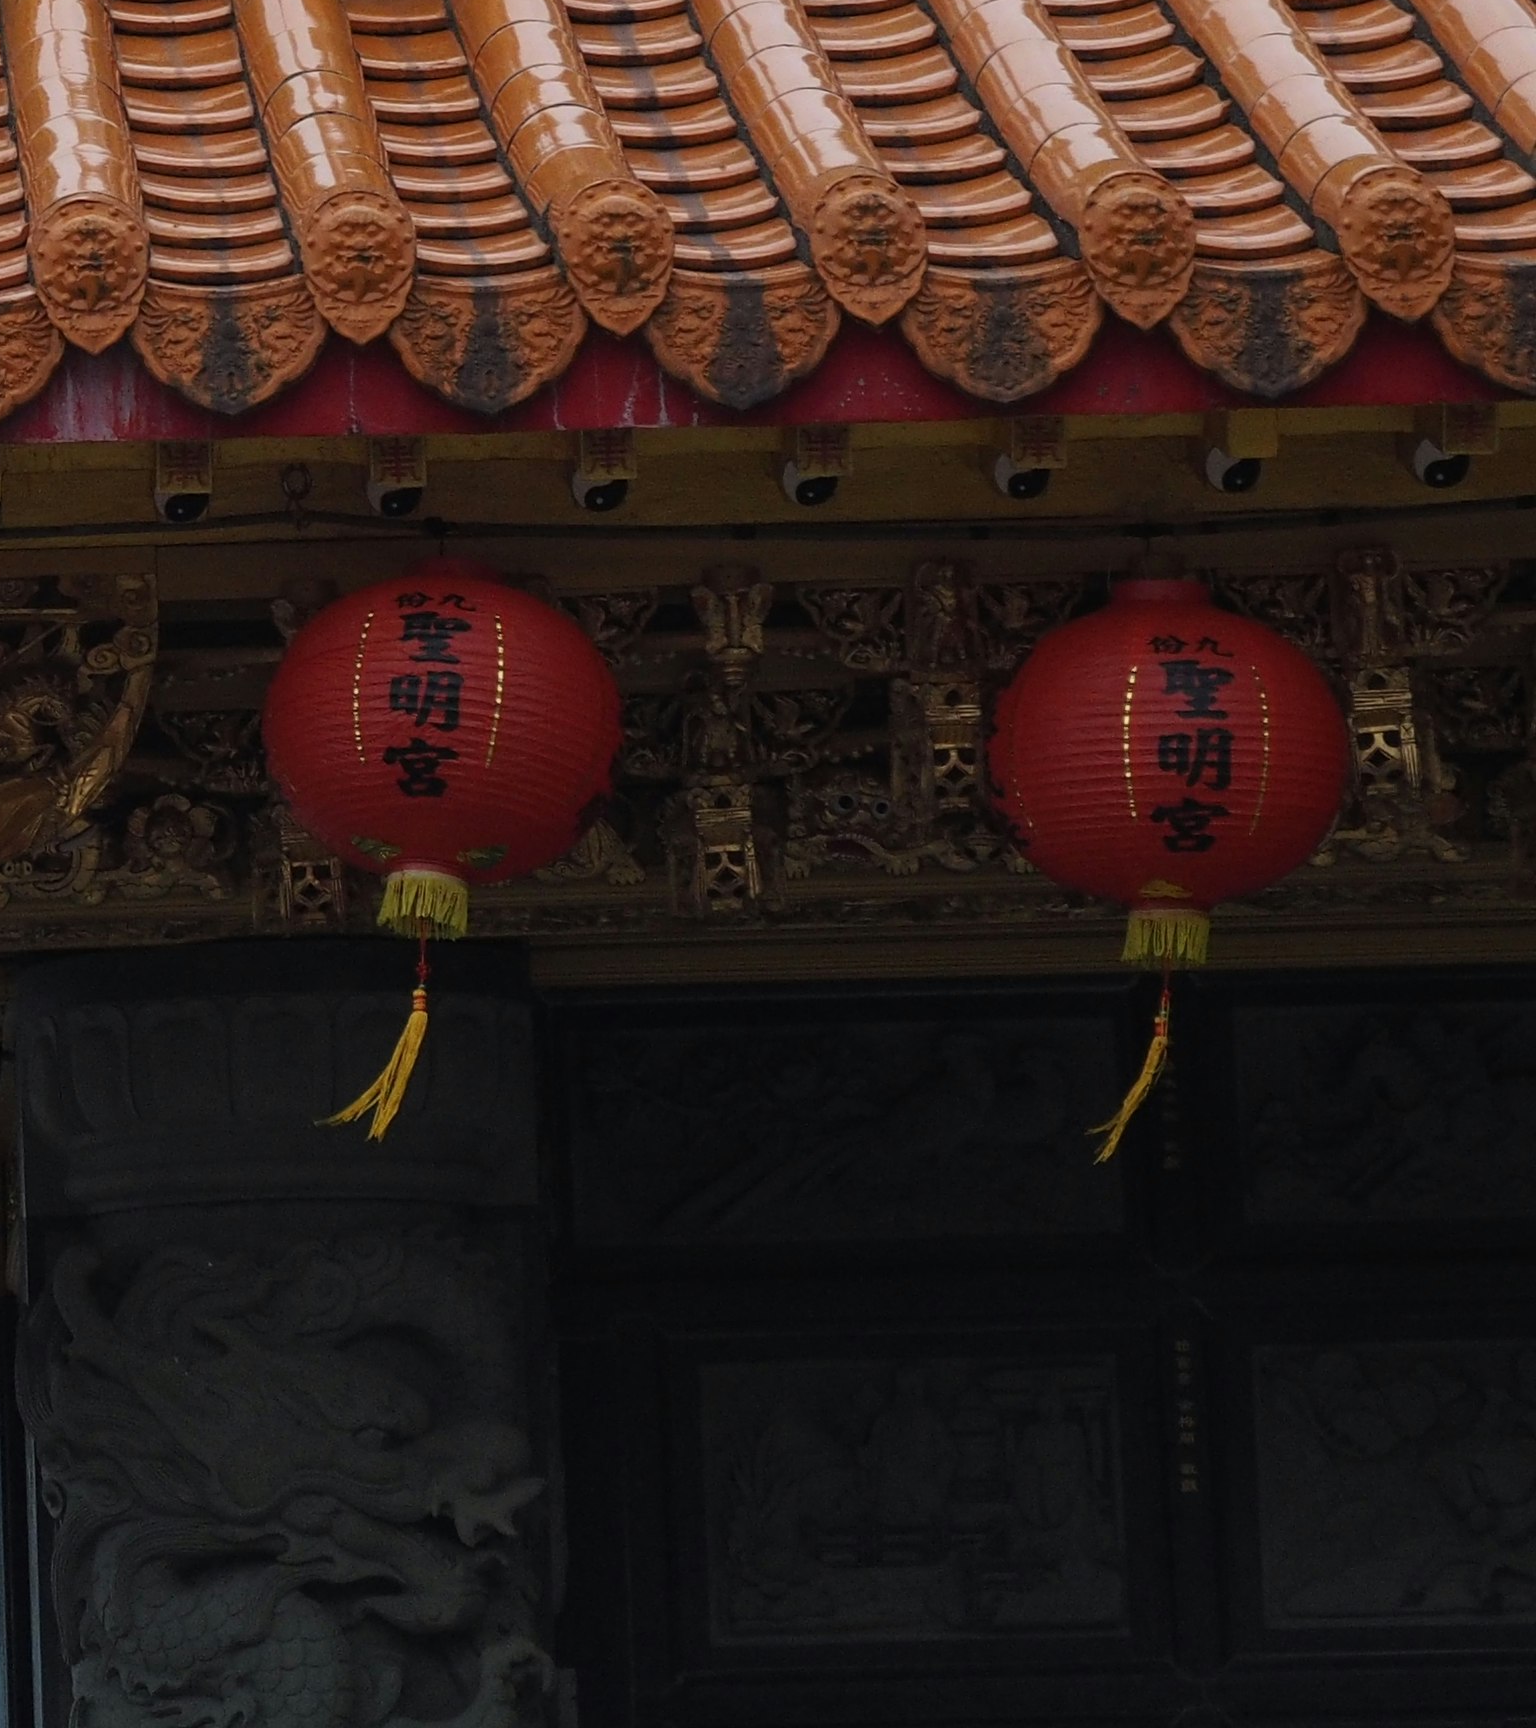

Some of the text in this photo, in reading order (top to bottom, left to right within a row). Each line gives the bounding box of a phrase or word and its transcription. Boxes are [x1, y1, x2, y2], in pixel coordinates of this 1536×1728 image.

[394, 591, 478, 613] 九份
[1145, 634, 1235, 658] 九份
[382, 610, 473, 799] 聖明宮
[1149, 657, 1235, 854] 聖明宮
